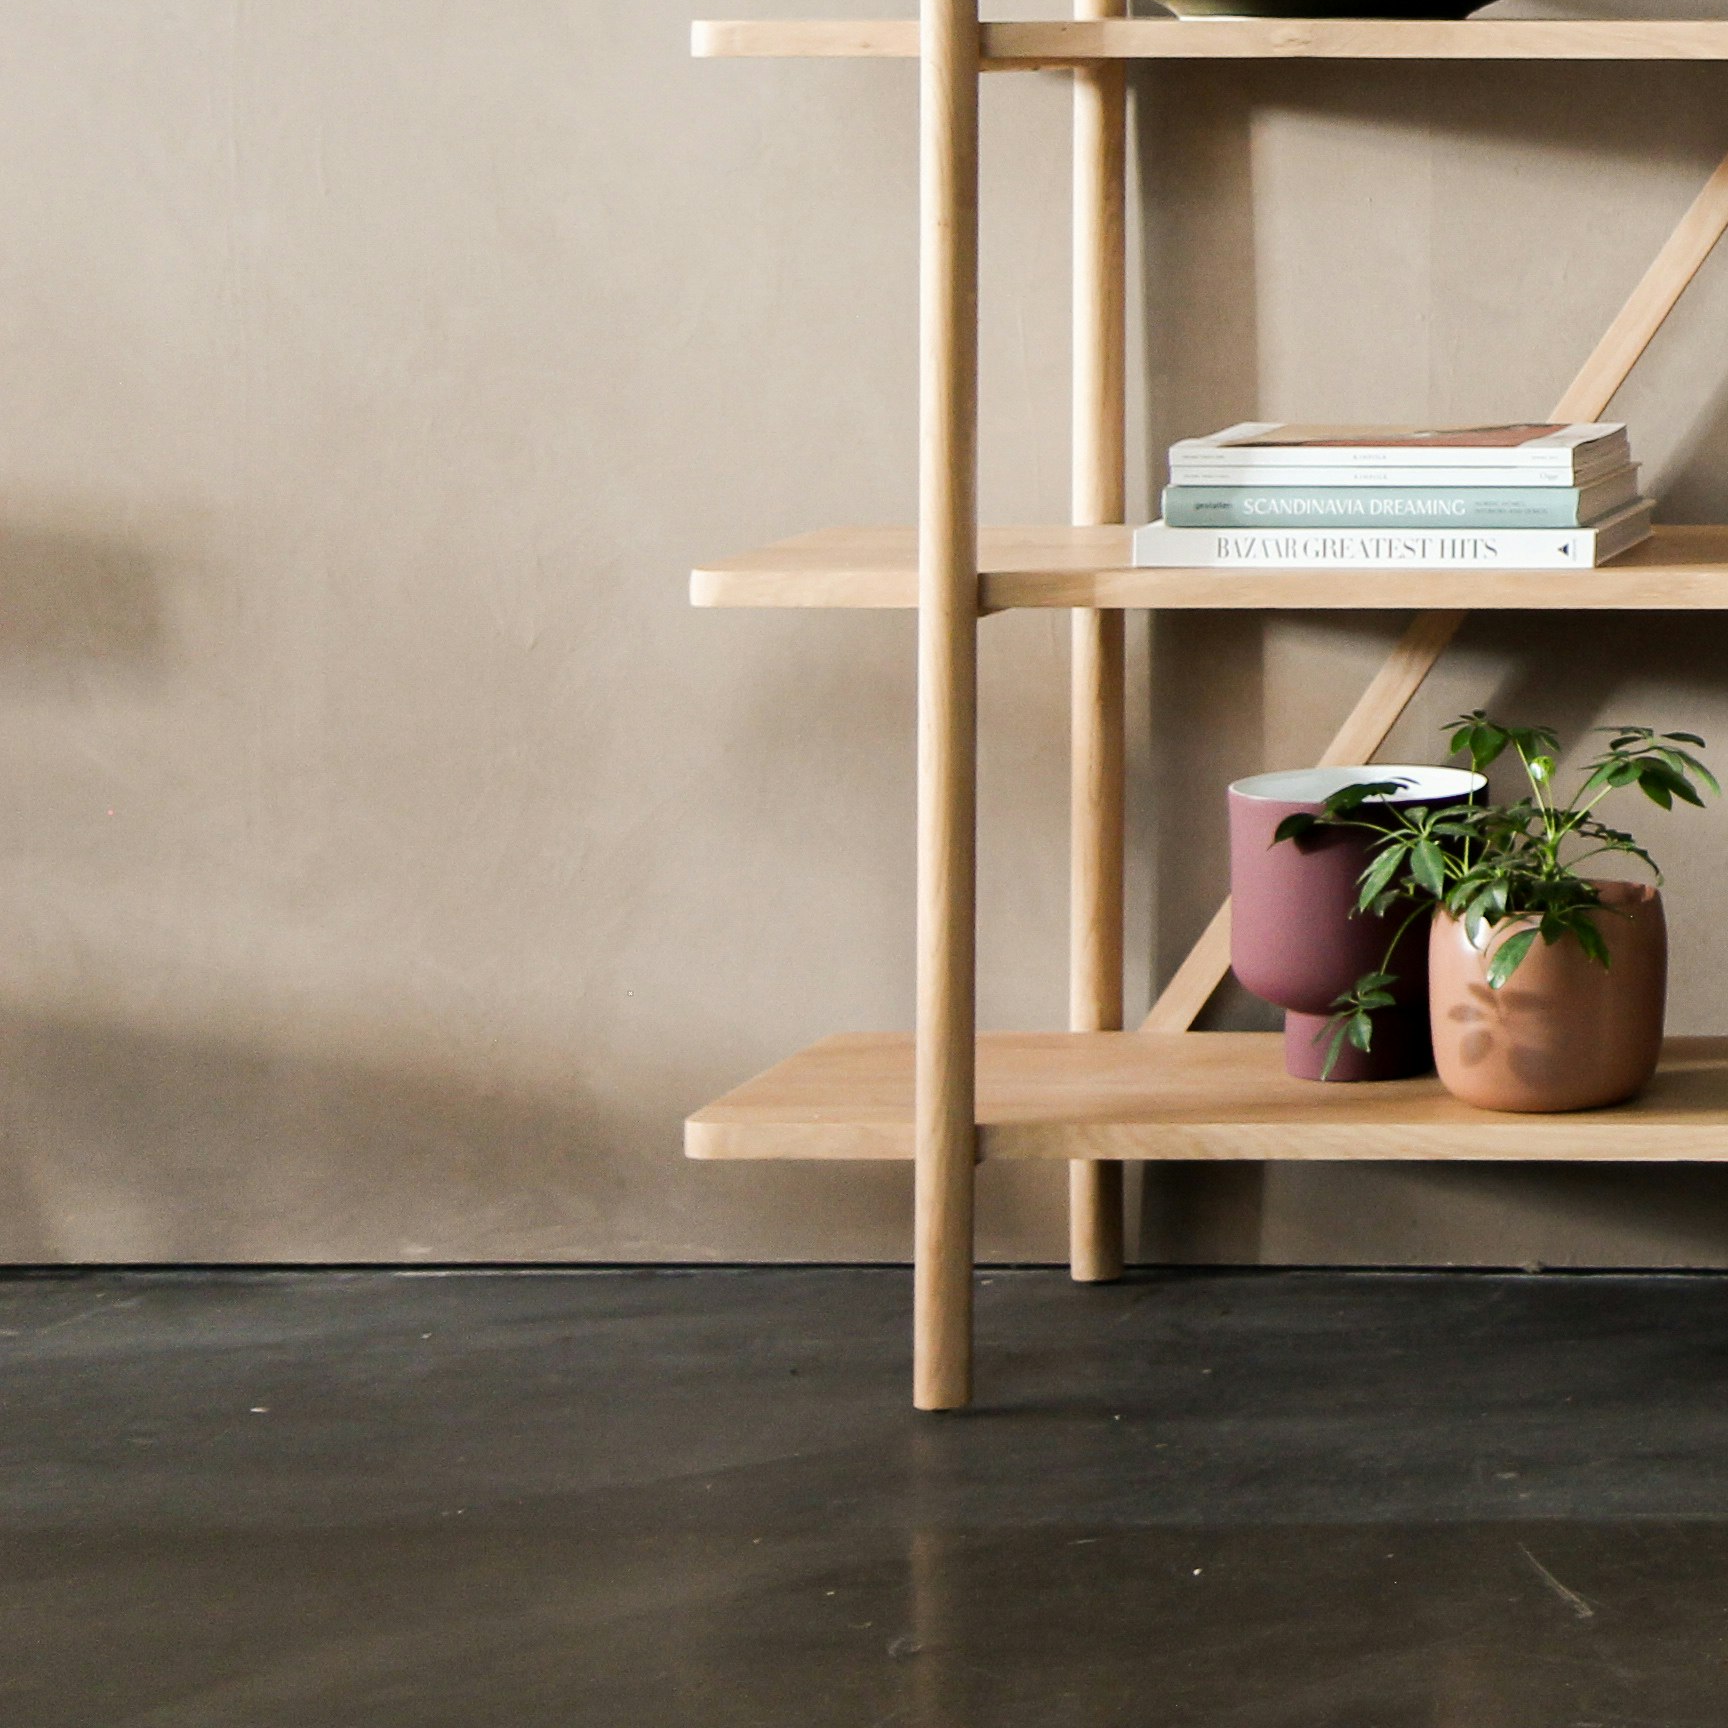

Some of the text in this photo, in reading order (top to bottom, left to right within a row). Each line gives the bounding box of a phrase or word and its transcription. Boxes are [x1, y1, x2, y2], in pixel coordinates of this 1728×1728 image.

[1243, 498, 1466, 516] SCANDINAVIA DREAMING
[1217, 537, 1498, 560] BAZAAR GREATEST HITS
